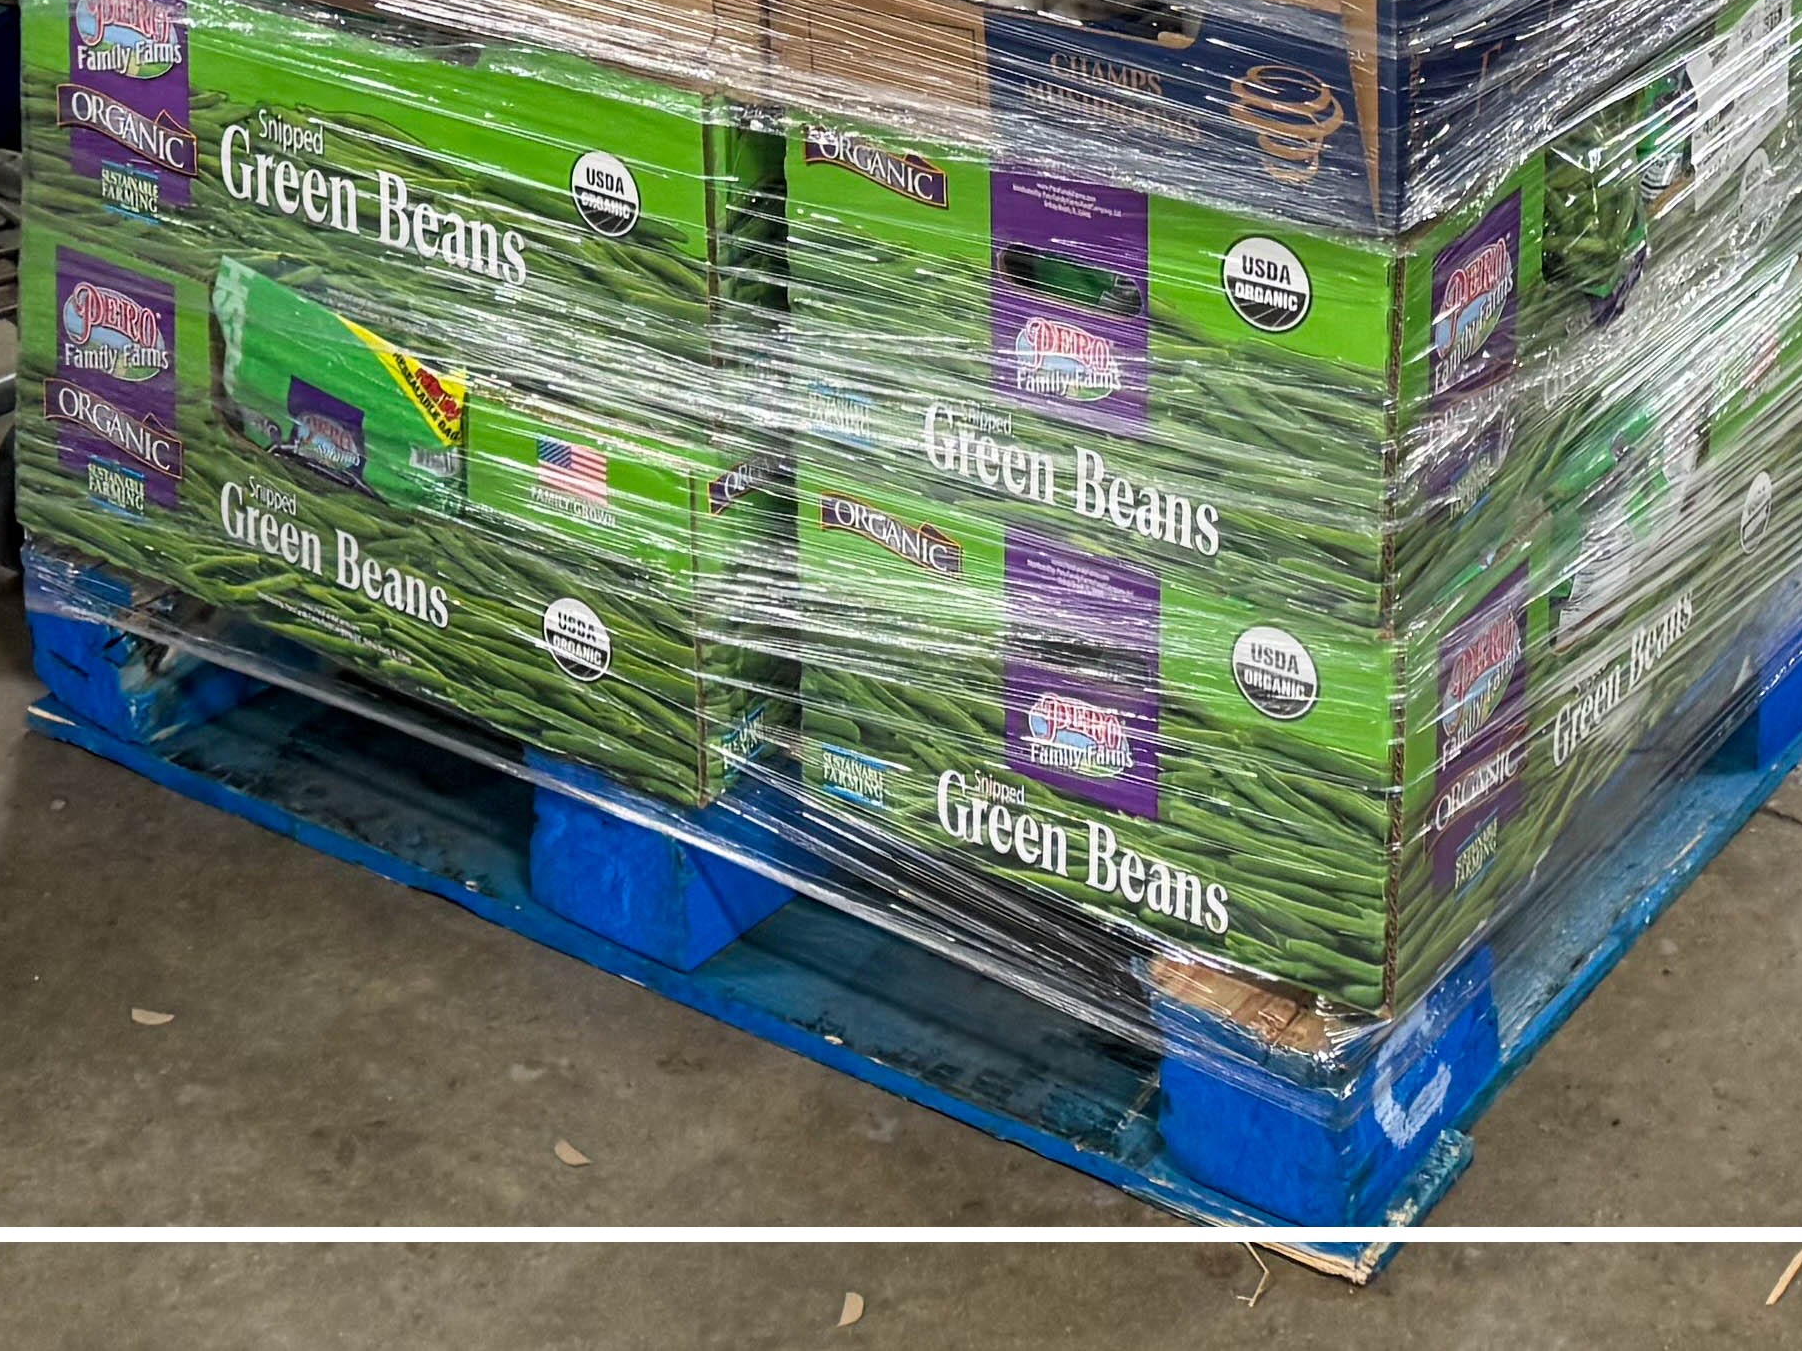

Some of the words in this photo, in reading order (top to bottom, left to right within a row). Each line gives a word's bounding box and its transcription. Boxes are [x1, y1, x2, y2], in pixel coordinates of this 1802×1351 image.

[77, 45, 131, 74] Family
[135, 41, 183, 66] Farms
[1049, 52, 1164, 96] CHAMPS
[71, 91, 185, 169] ORGANIC
[258, 109, 324, 156] Snipped
[585, 167, 625, 194] USDA
[818, 132, 935, 200] ORGANIC
[102, 182, 158, 214] FARMING
[220, 125, 360, 235] Green
[375, 169, 528, 286] Beans
[1241, 255, 1293, 286] USDA
[74, 281, 160, 349] PERO
[1233, 282, 1299, 313] ORGANIC
[65, 344, 118, 374] Family
[123, 344, 169, 370] Farms
[1025, 318, 1114, 371] PERO
[1017, 367, 1071, 396] Family
[58, 387, 171, 471] ORGANIC
[248, 476, 297, 516] Snipped
[924, 401, 1056, 507] Green
[1072, 445, 1220, 556] Beans
[220, 481, 322, 576] Green
[334, 528, 449, 629] Beans
[835, 499, 948, 573] ORGANIC
[557, 611, 597, 643] USDA
[551, 634, 603, 667] ORGANIC
[1249, 641, 1300, 676] USDA
[1243, 670, 1306, 701] ORGANIC
[1553, 664, 1621, 767] Green
[1629, 592, 1693, 692] Beans
[1030, 744, 1081, 773] Family
[974, 769, 1026, 805] Snipped
[936, 768, 1069, 877] Green
[1084, 819, 1230, 935] Beans
